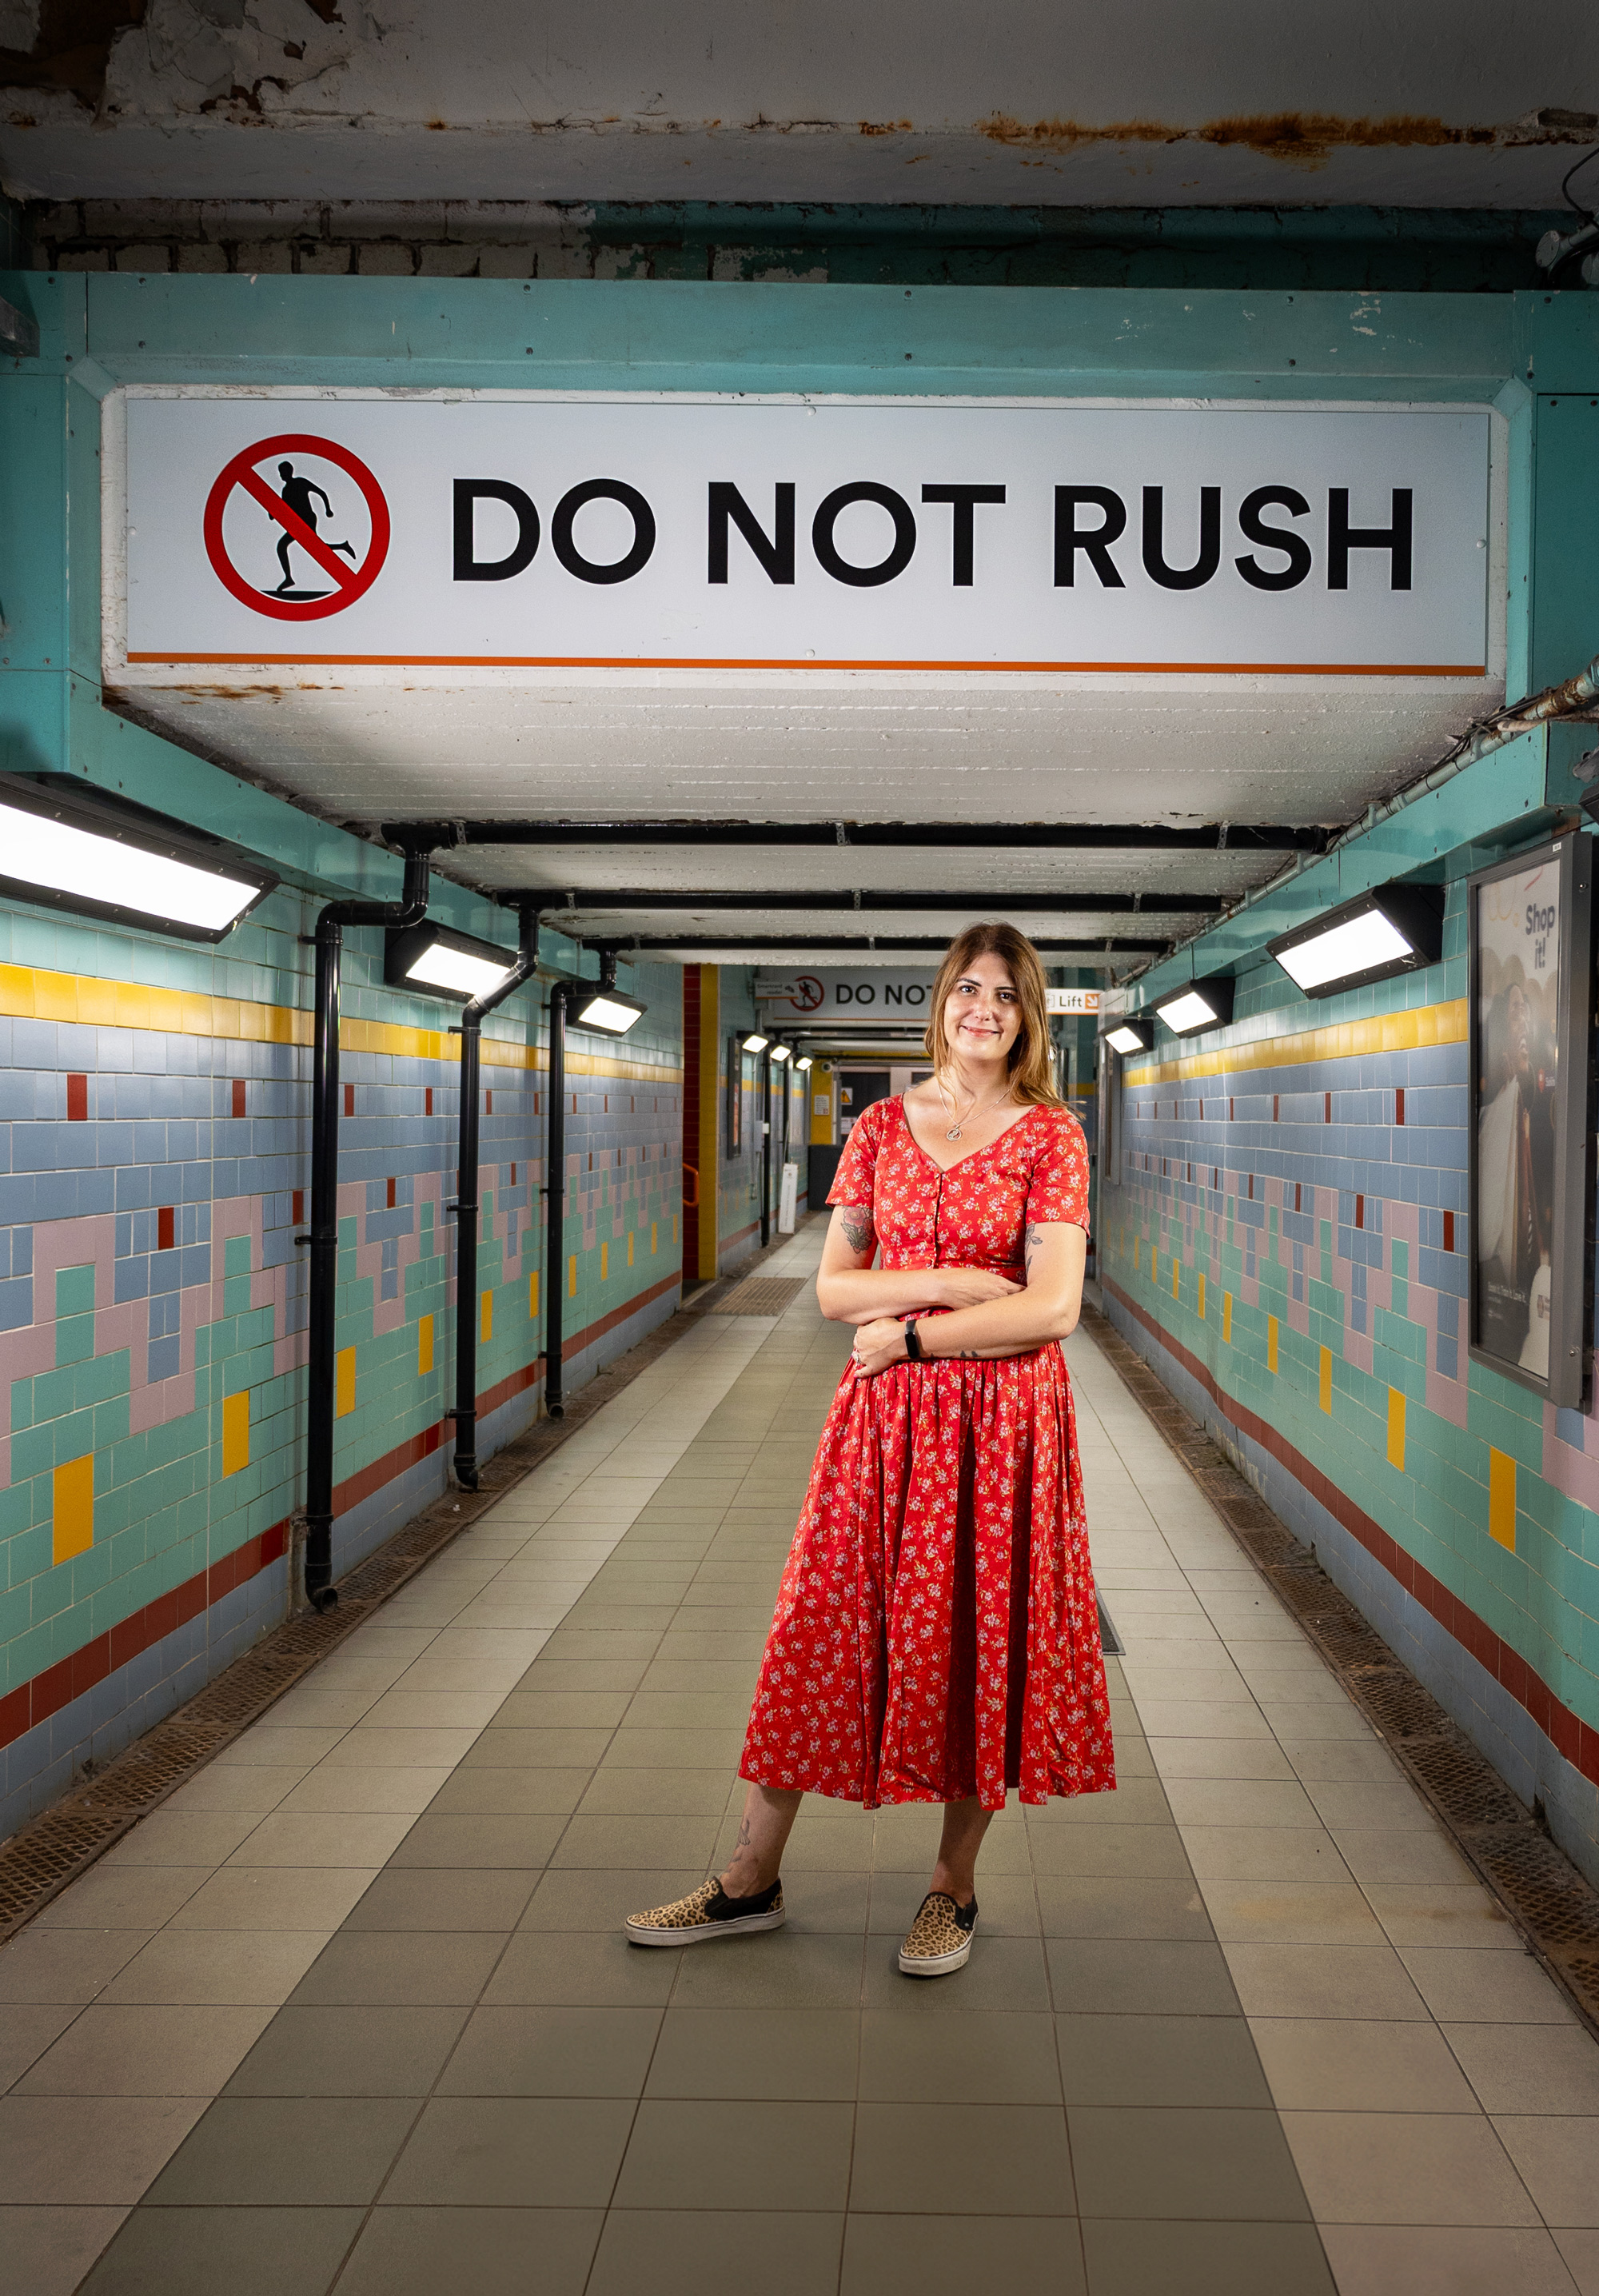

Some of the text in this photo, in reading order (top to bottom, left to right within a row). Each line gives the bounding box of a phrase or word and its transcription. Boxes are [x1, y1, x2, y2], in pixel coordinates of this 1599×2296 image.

[453, 479, 1413, 591] DO NOT RUSH
[1526, 903, 1555, 937] Shop
[1535, 937, 1545, 969] it!
[834, 981, 933, 1005] DO NO
[1059, 996, 1082, 1007] Lift
